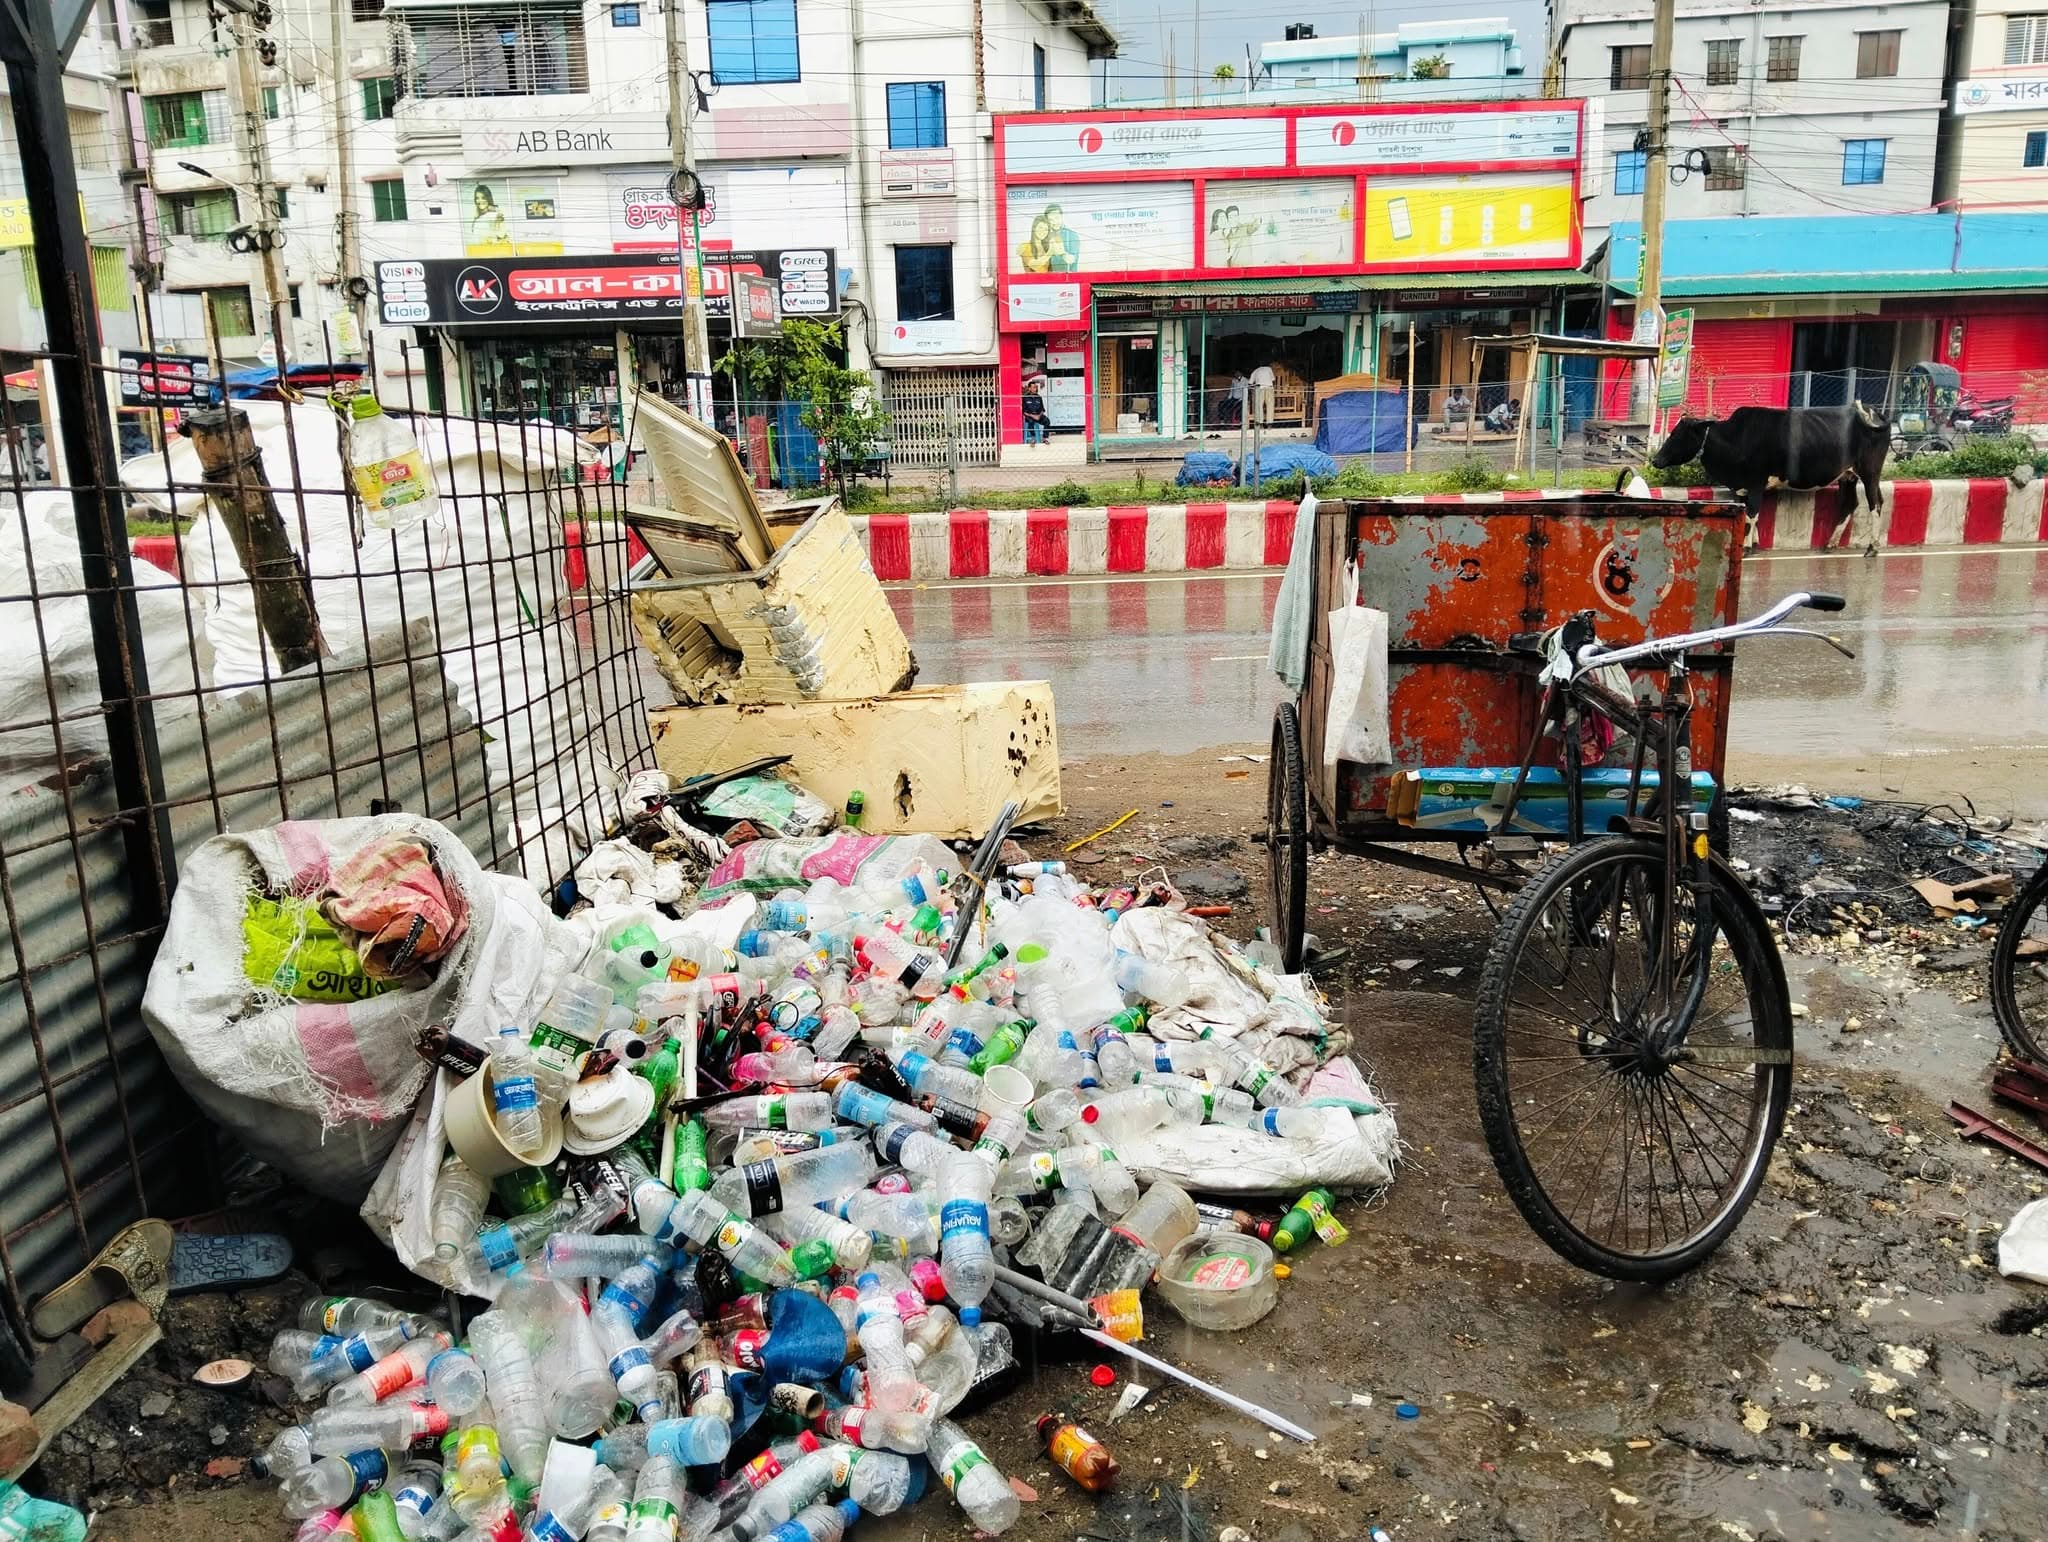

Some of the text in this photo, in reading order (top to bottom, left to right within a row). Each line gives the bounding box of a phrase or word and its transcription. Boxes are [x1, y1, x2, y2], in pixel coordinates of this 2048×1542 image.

[516, 128, 613, 153] AB Bank
[794, 257, 825, 265] GREE
[382, 267, 423, 277] VISION
[388, 306, 428, 317] Haier
